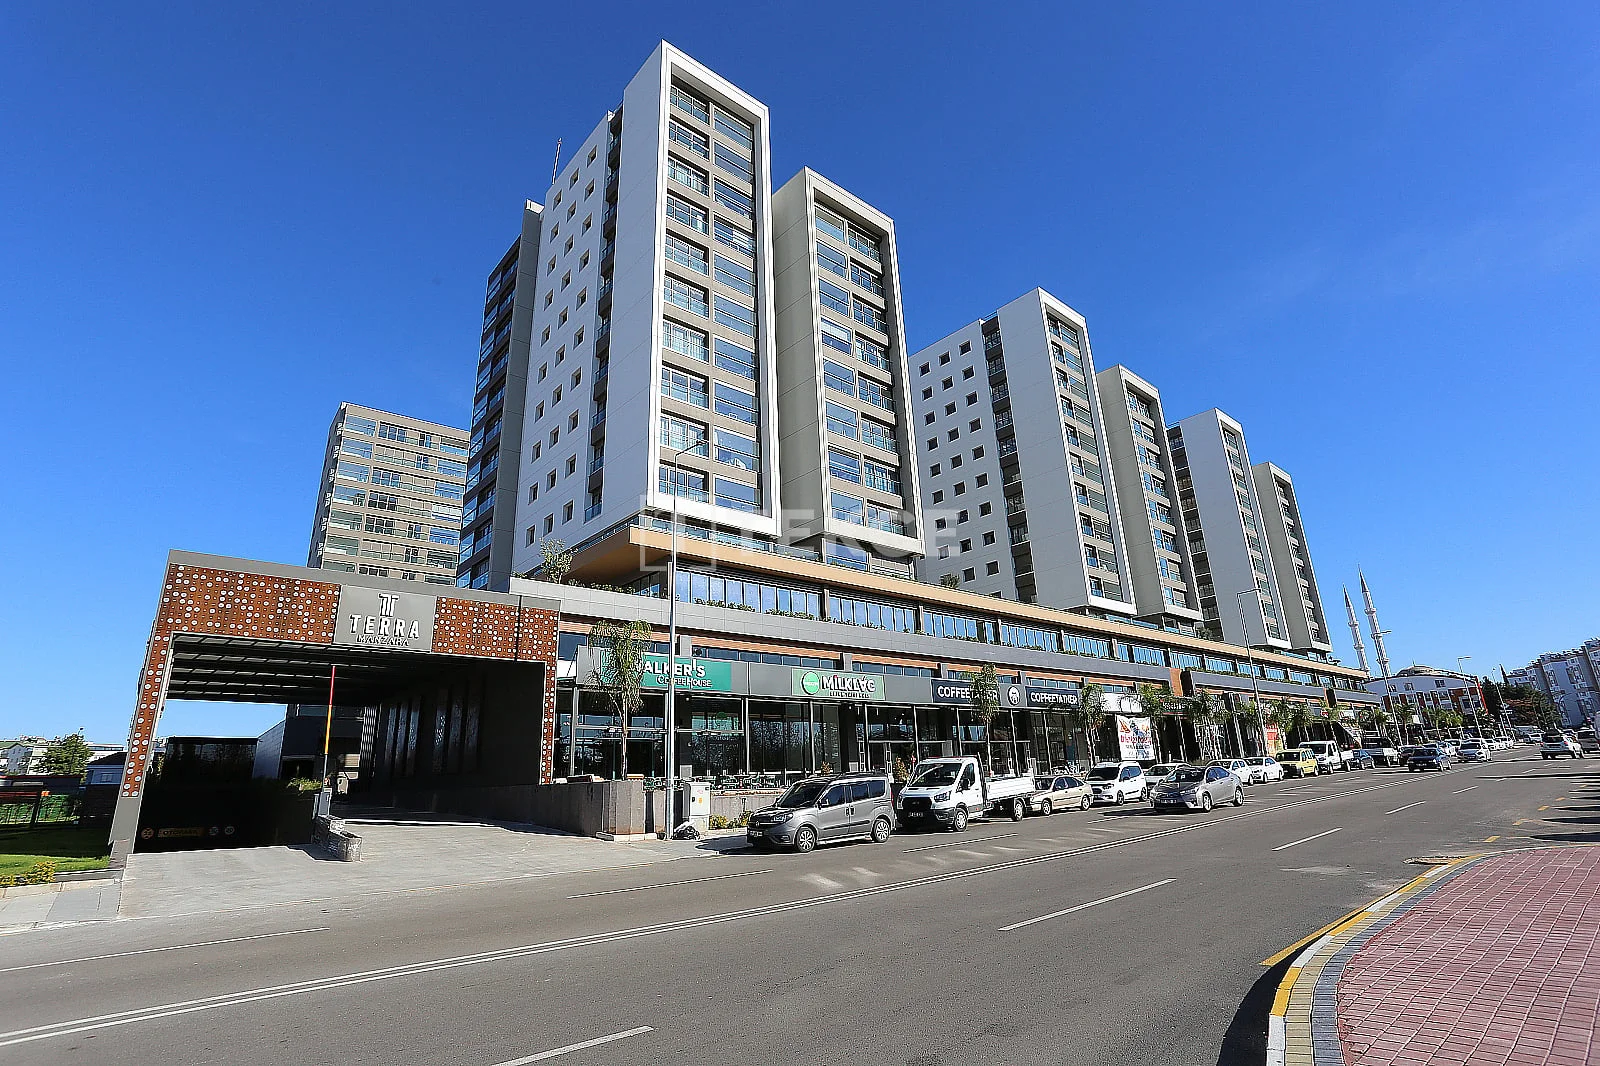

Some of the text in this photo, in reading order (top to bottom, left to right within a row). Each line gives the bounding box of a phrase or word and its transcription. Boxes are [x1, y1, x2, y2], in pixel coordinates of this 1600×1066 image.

[349, 614, 419, 639] TERRA
[657, 675, 686, 686] COFEE
[937, 685, 998, 701] COFFEETER
